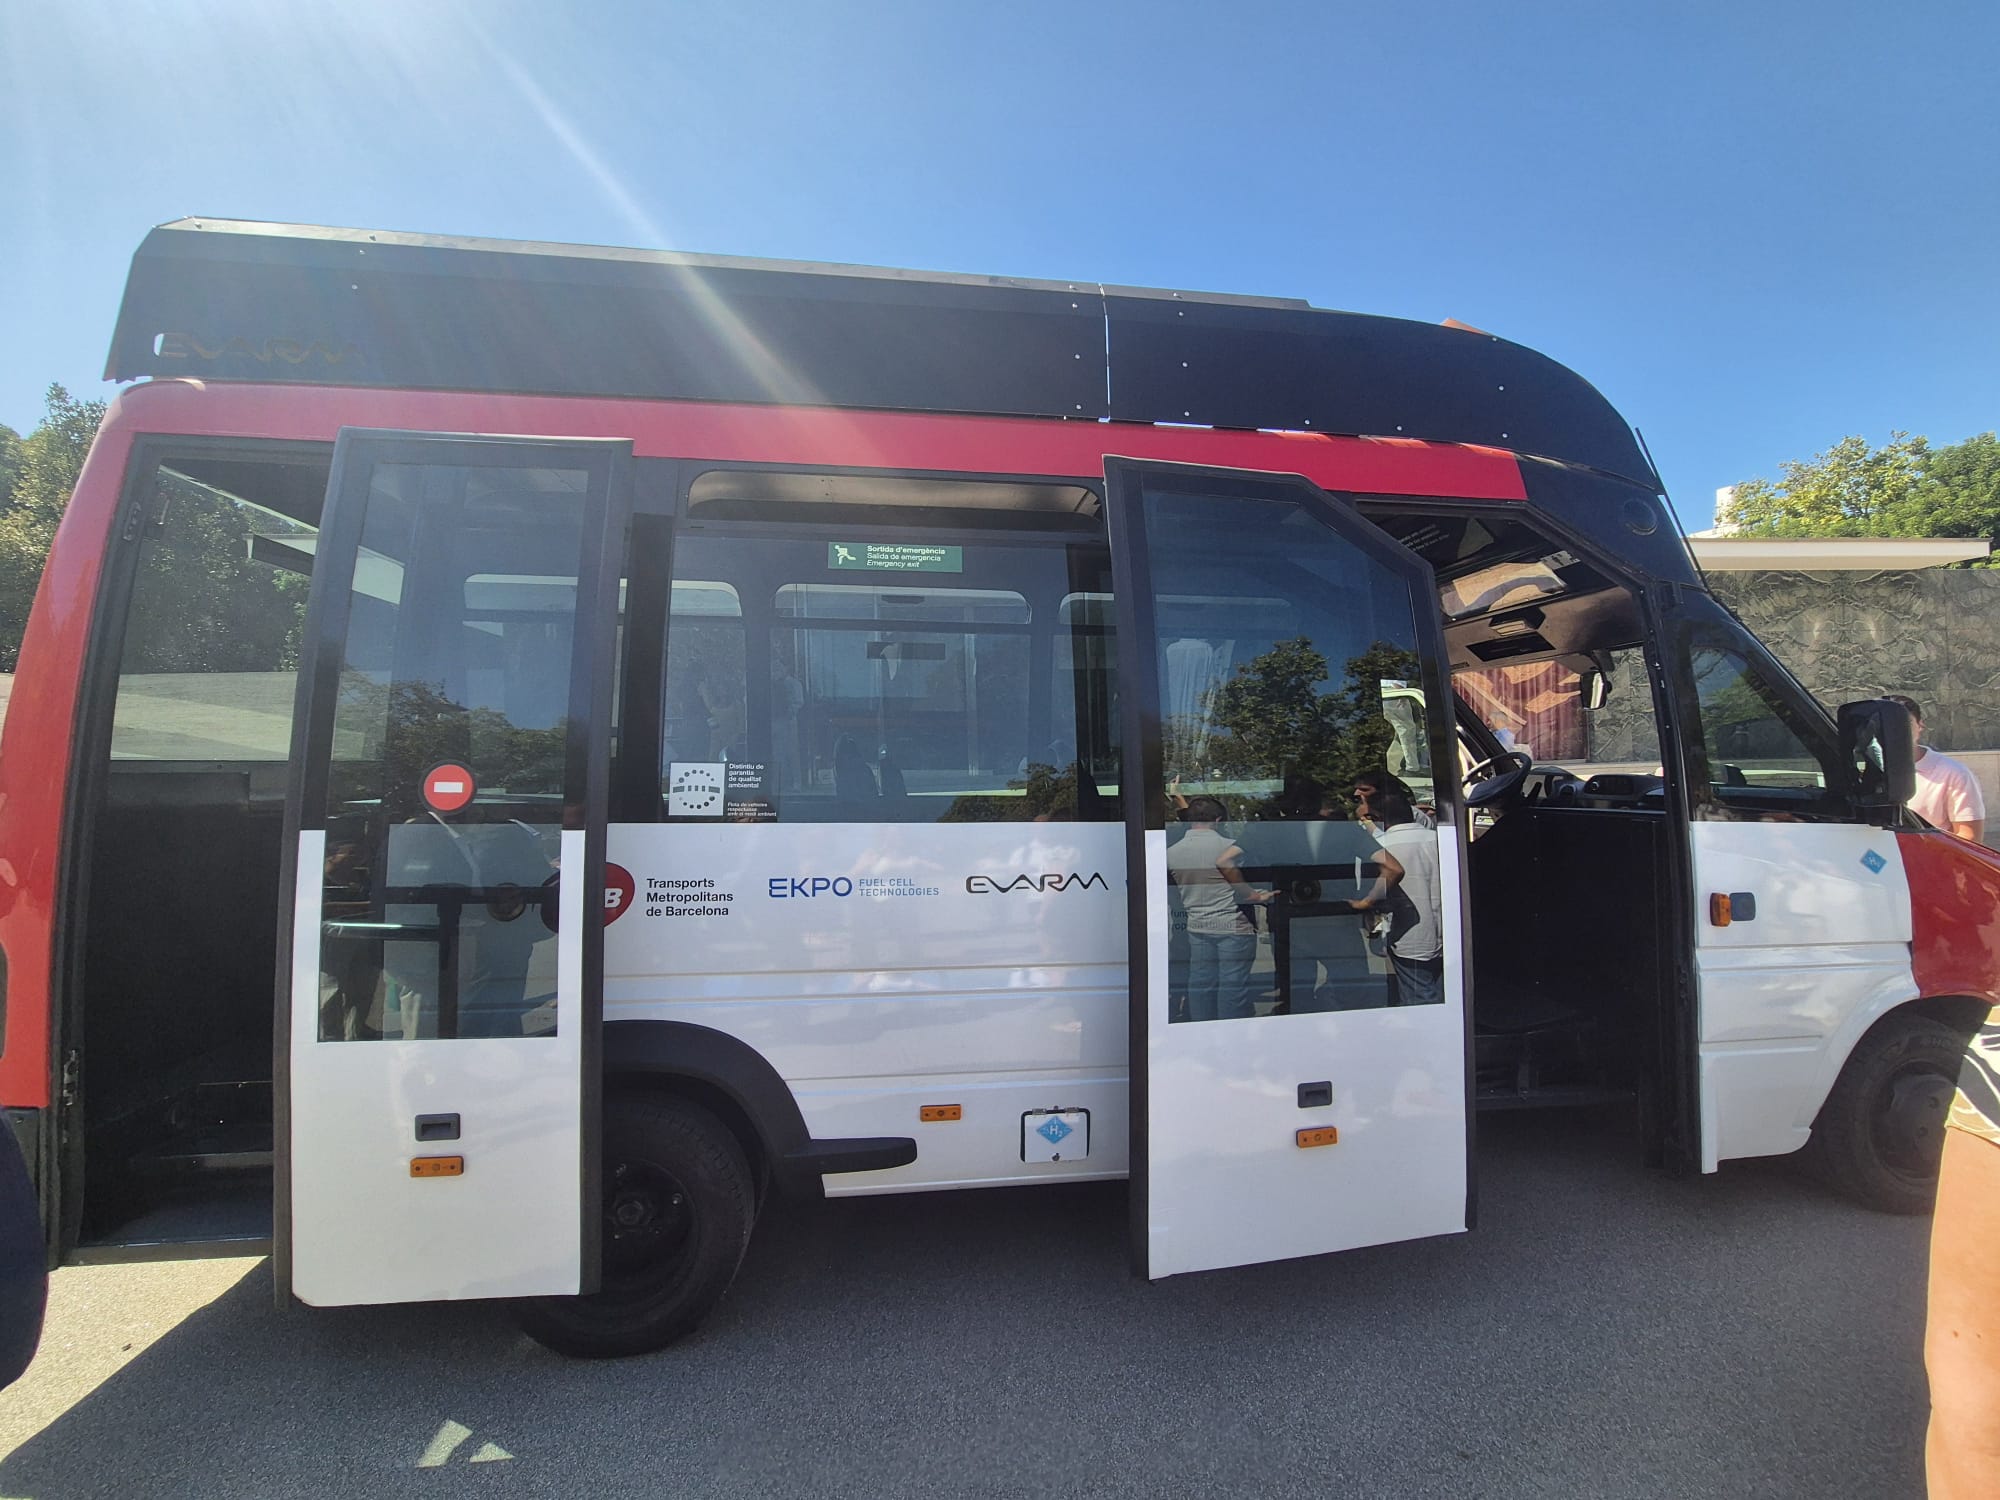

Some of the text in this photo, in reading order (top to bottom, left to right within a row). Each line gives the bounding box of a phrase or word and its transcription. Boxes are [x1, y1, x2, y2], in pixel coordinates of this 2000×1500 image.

[867, 545, 946, 556] Sortida d'emergència
[901, 554, 941, 562] emergencia
[867, 560, 905, 568] Emergency
[646, 878, 715, 890] Transports
[768, 876, 853, 898] EKPO
[859, 878, 915, 887] FUEL CELL
[965, 872, 1109, 894] EVARM
[860, 887, 940, 897] TECHNOLOGIES
[646, 891, 734, 904] Metropolitans
[646, 906, 729, 916] de Barcelona
